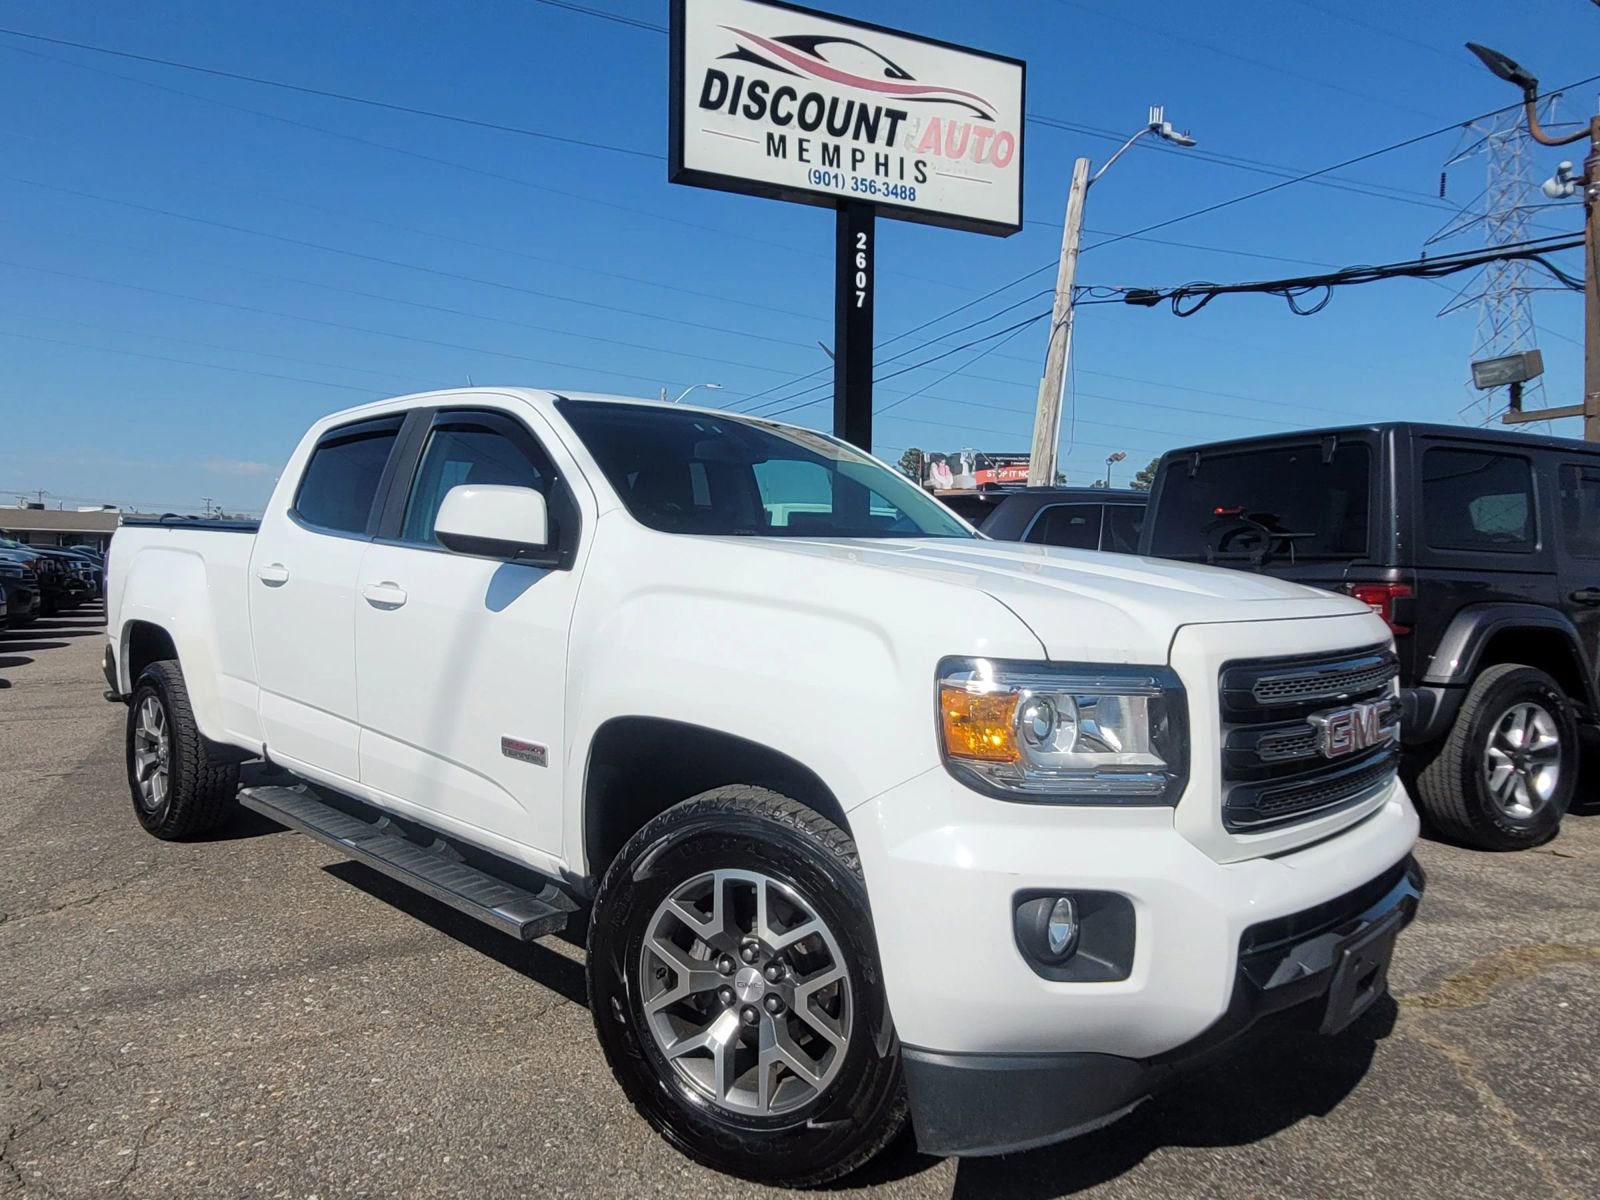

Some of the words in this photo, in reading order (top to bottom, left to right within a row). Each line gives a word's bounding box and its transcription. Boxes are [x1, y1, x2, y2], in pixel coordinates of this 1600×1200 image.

[698, 68, 908, 148] DISCOUNT
[916, 116, 1016, 169] AUTO
[766, 132, 928, 185] MEMPHIS
[808, 168, 846, 190] (901)
[851, 176, 917, 202] 356-3488
[855, 232, 867, 308] 2607
[1009, 470, 1017, 478] IT
[1325, 699, 1394, 759] GMC
